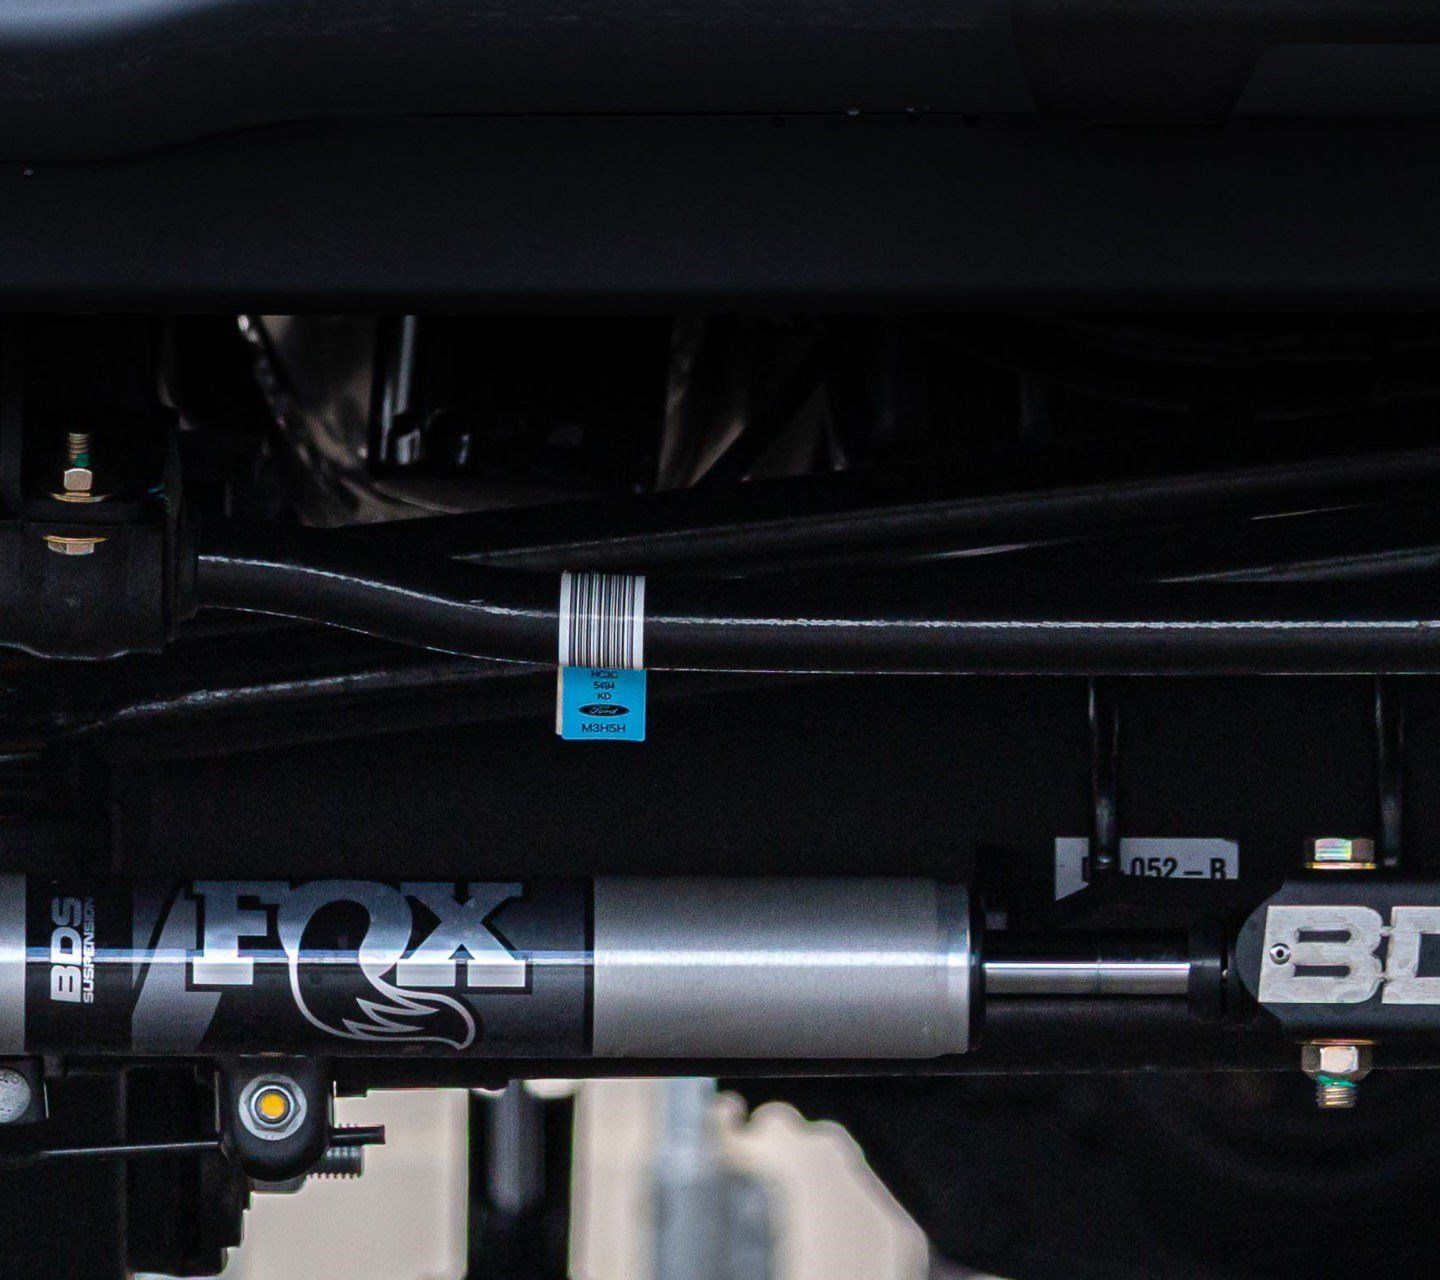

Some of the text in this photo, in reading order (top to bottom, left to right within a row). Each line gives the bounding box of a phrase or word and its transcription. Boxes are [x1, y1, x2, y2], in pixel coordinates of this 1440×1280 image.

[581, 723, 626, 734] M3H5H
[50, 896, 83, 1003] BDS
[82, 896, 95, 1004] SUSPENSION
[191, 879, 528, 1049] FOX
